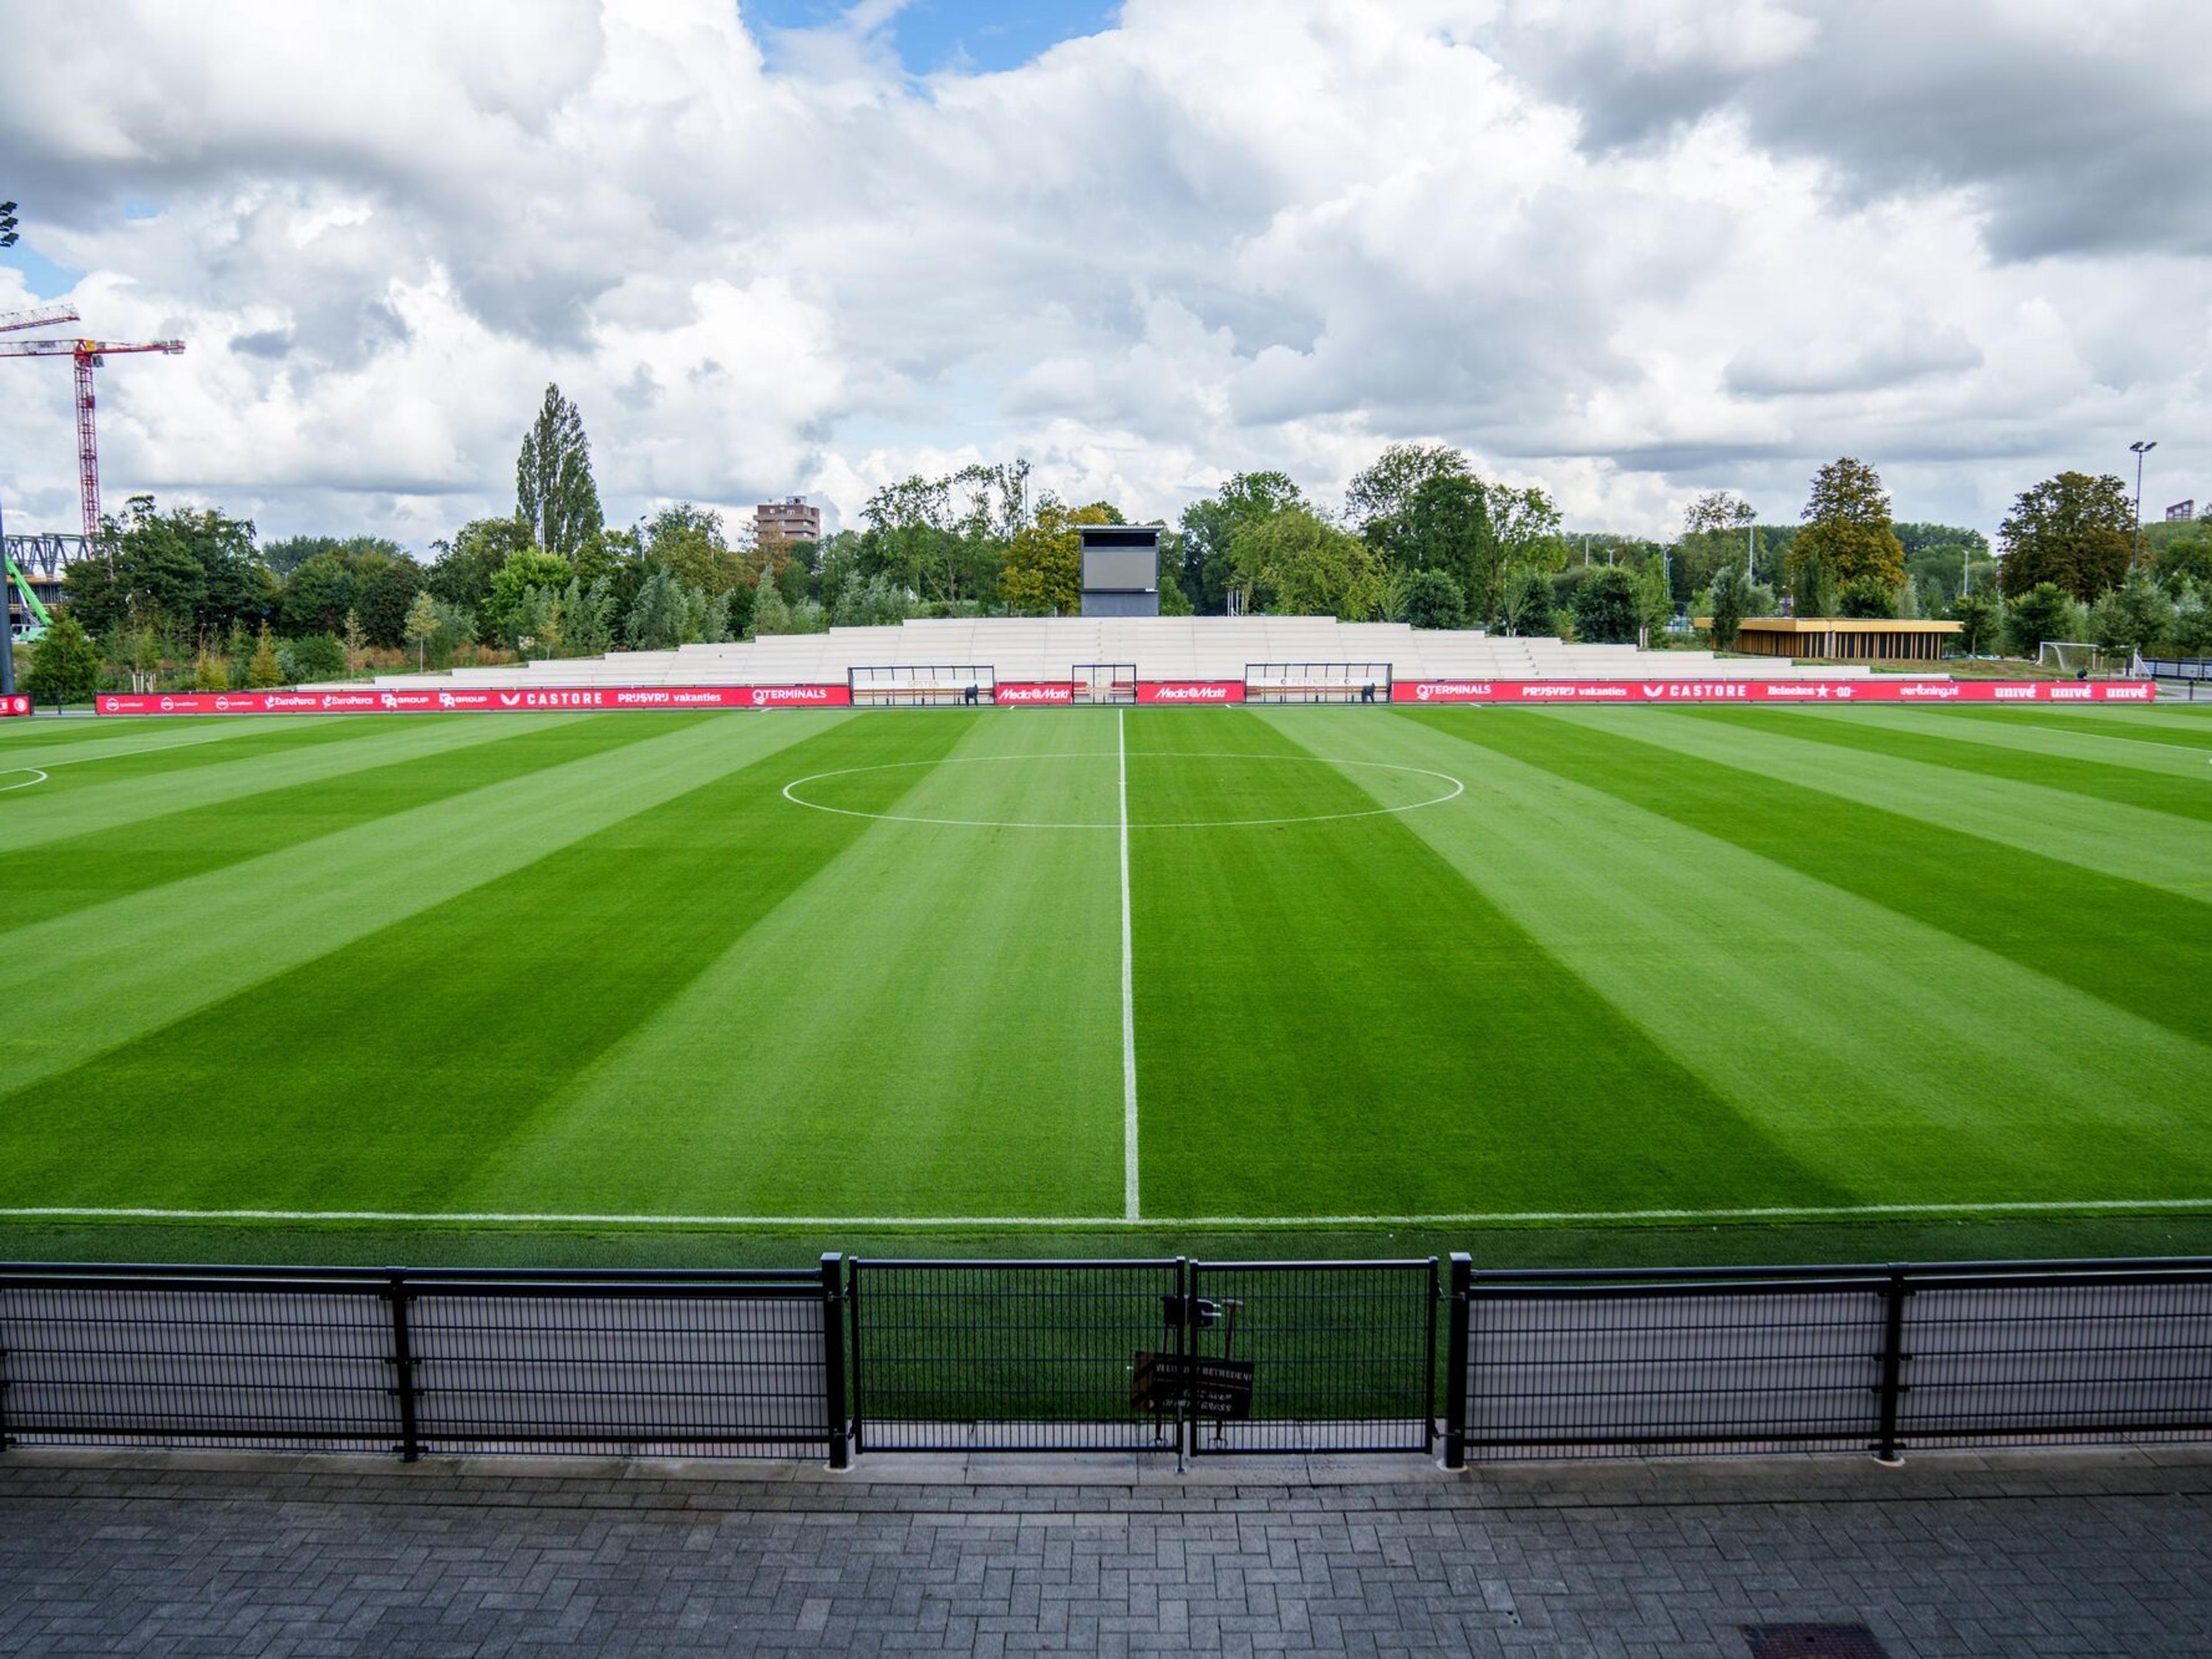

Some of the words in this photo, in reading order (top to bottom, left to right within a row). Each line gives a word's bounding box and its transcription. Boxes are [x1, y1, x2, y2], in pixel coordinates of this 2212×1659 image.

[1578, 687, 1627, 696] vakanties
[1670, 685, 1746, 697] CASTORE
[1767, 686, 1814, 695] Heineken
[1994, 684, 2036, 698] univé
[2050, 684, 2092, 698] univé
[2106, 684, 2148, 698] univé
[275, 697, 316, 706] EuroParcs
[332, 696, 373, 705] EuroParcs
[527, 693, 602, 704] CASTORE
[674, 693, 721, 702] vakanties
